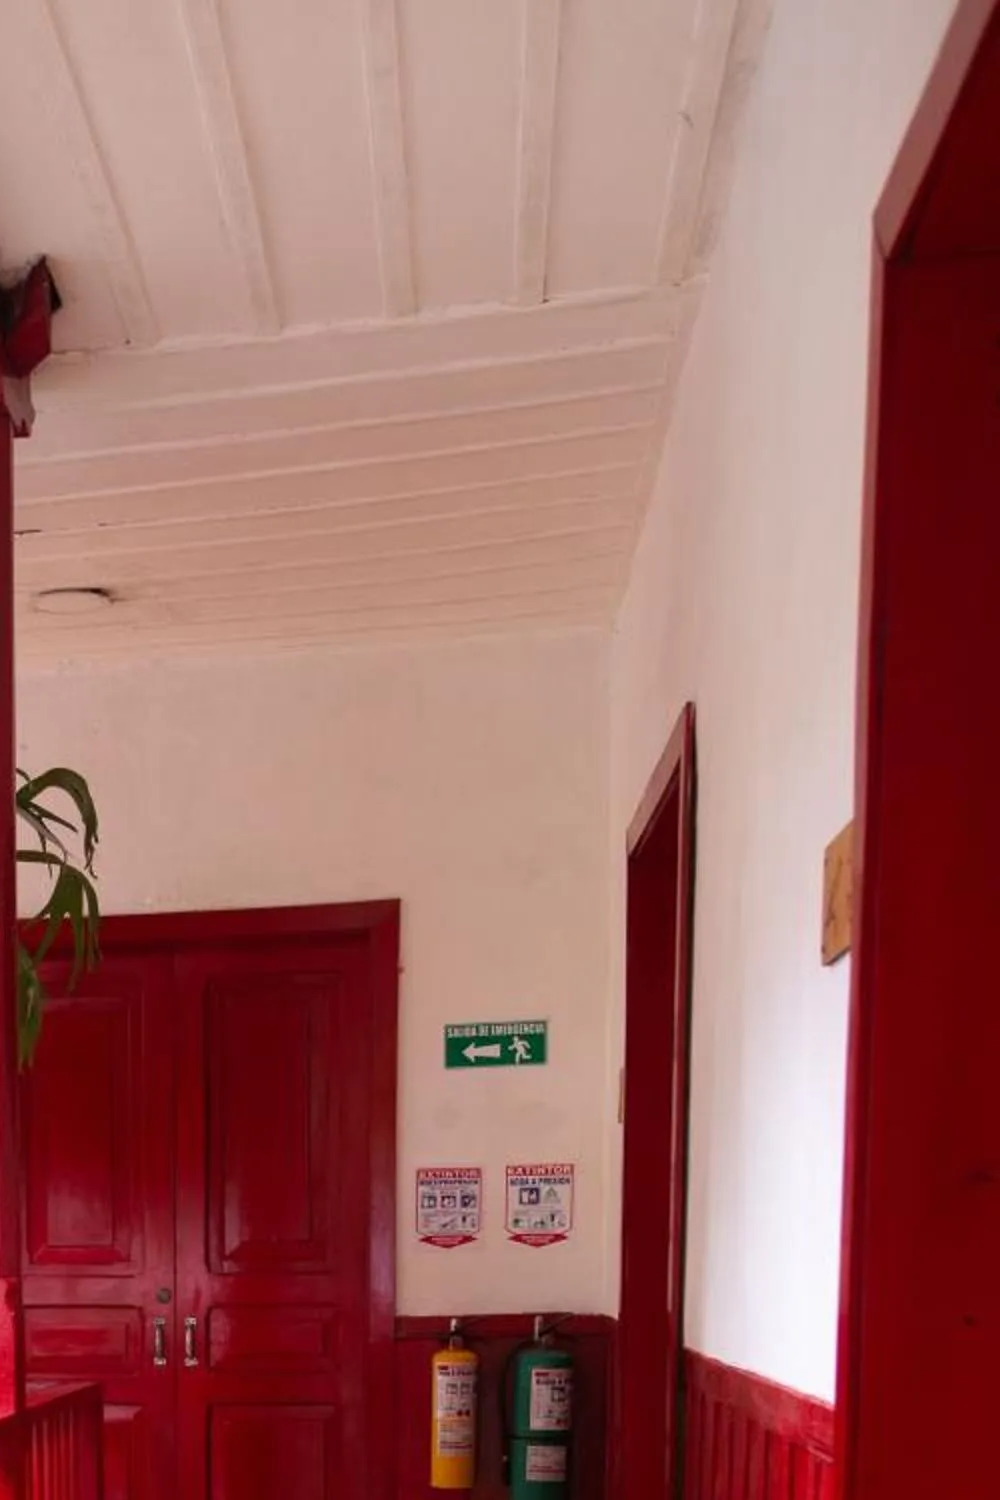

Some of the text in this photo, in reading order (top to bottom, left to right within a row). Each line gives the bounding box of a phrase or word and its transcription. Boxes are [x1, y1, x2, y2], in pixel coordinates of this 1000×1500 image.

[447, 1023, 545, 1038] SALIDA DE EMERGENCIA
